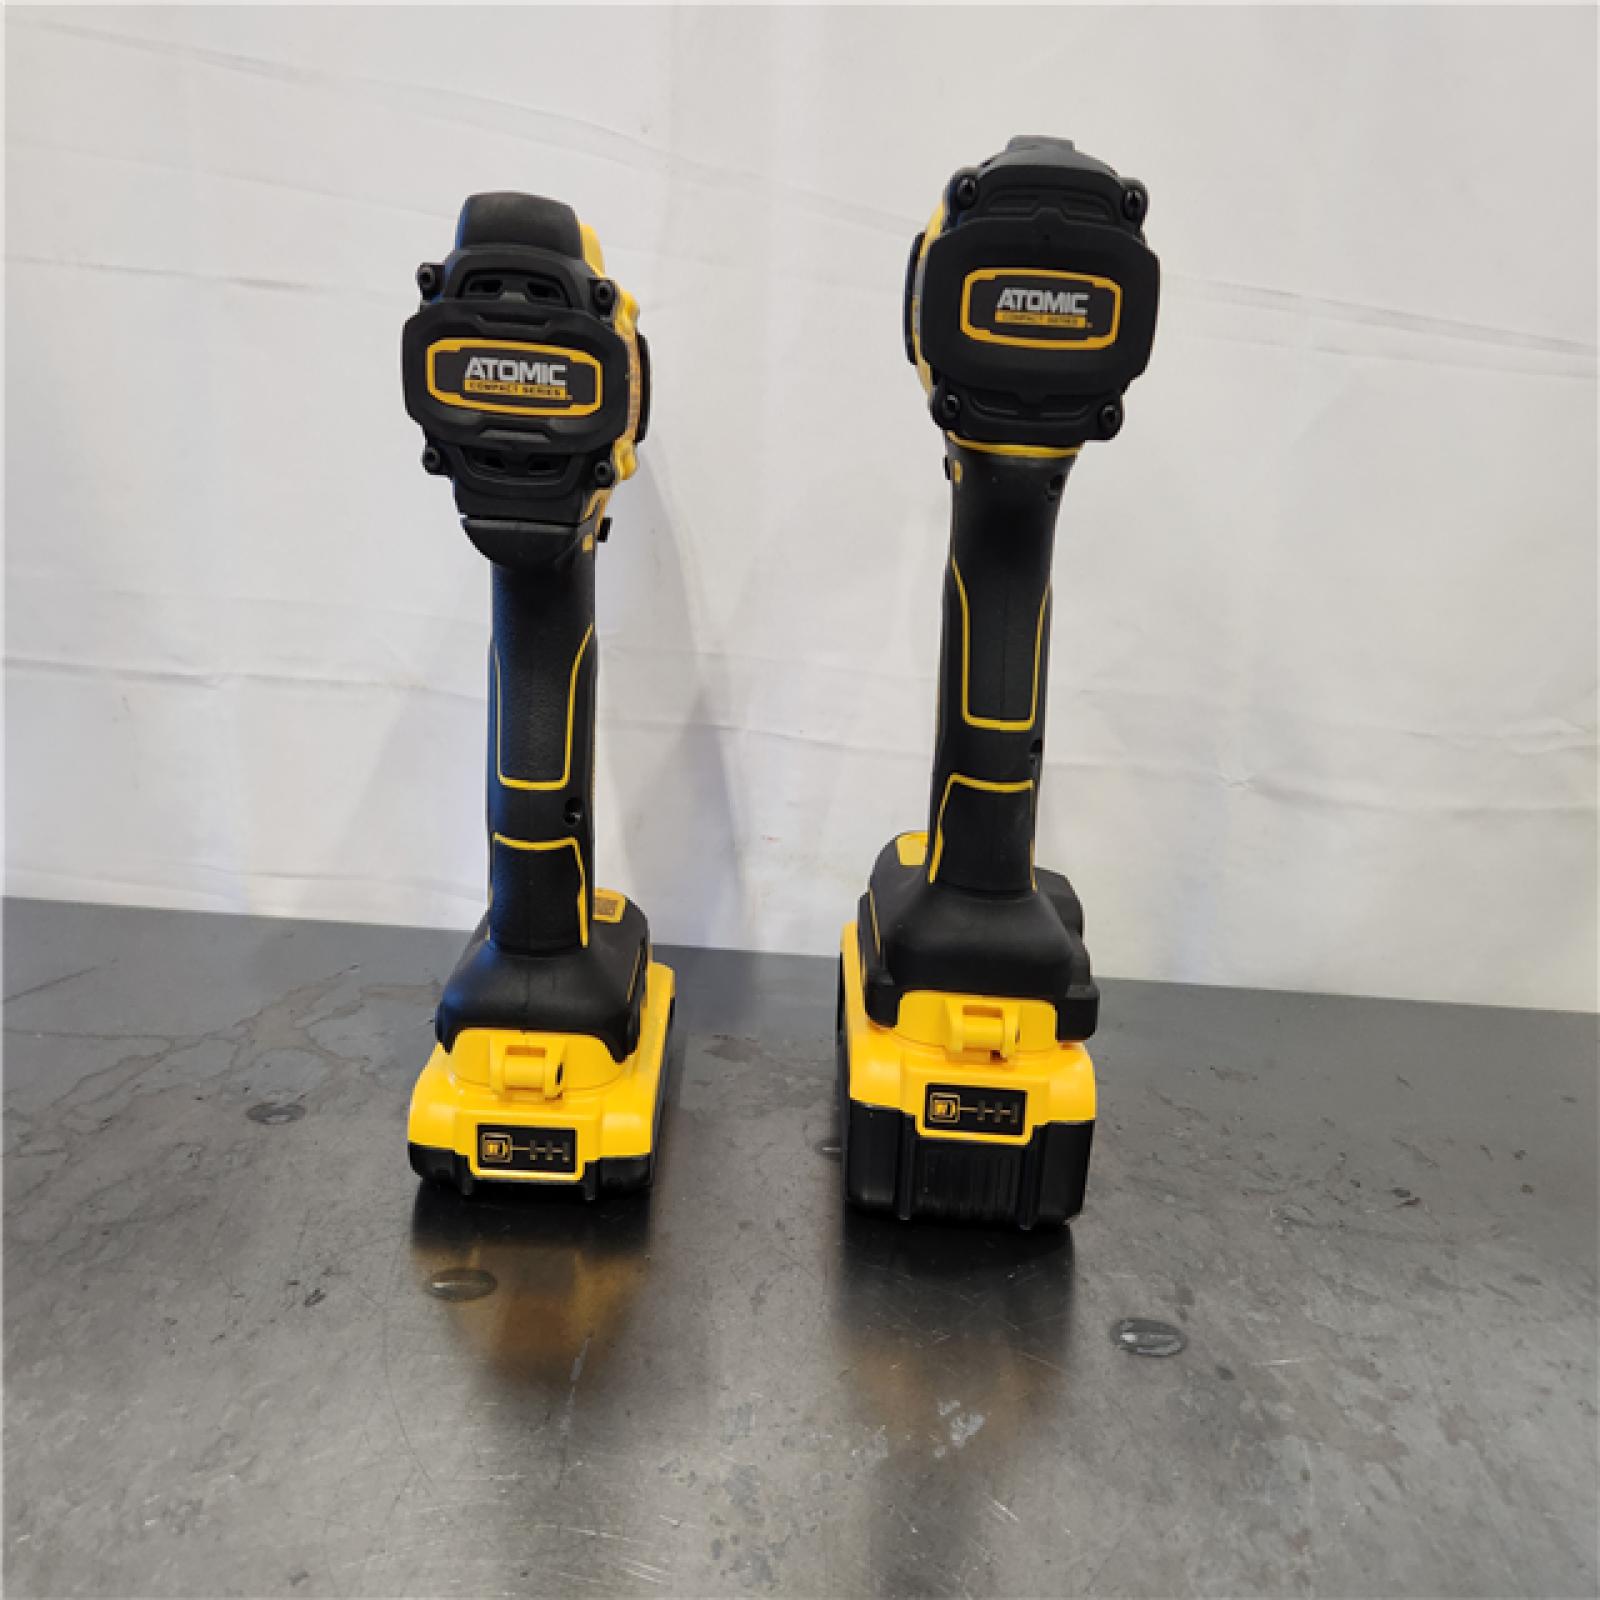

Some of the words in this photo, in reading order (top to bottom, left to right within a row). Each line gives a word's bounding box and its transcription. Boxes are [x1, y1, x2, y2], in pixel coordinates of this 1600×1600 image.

[996, 287, 1089, 315] ATOMIC
[464, 357, 567, 386] ATOMIC
[468, 381, 518, 394] COMPACT
[521, 384, 562, 398] SERIES
